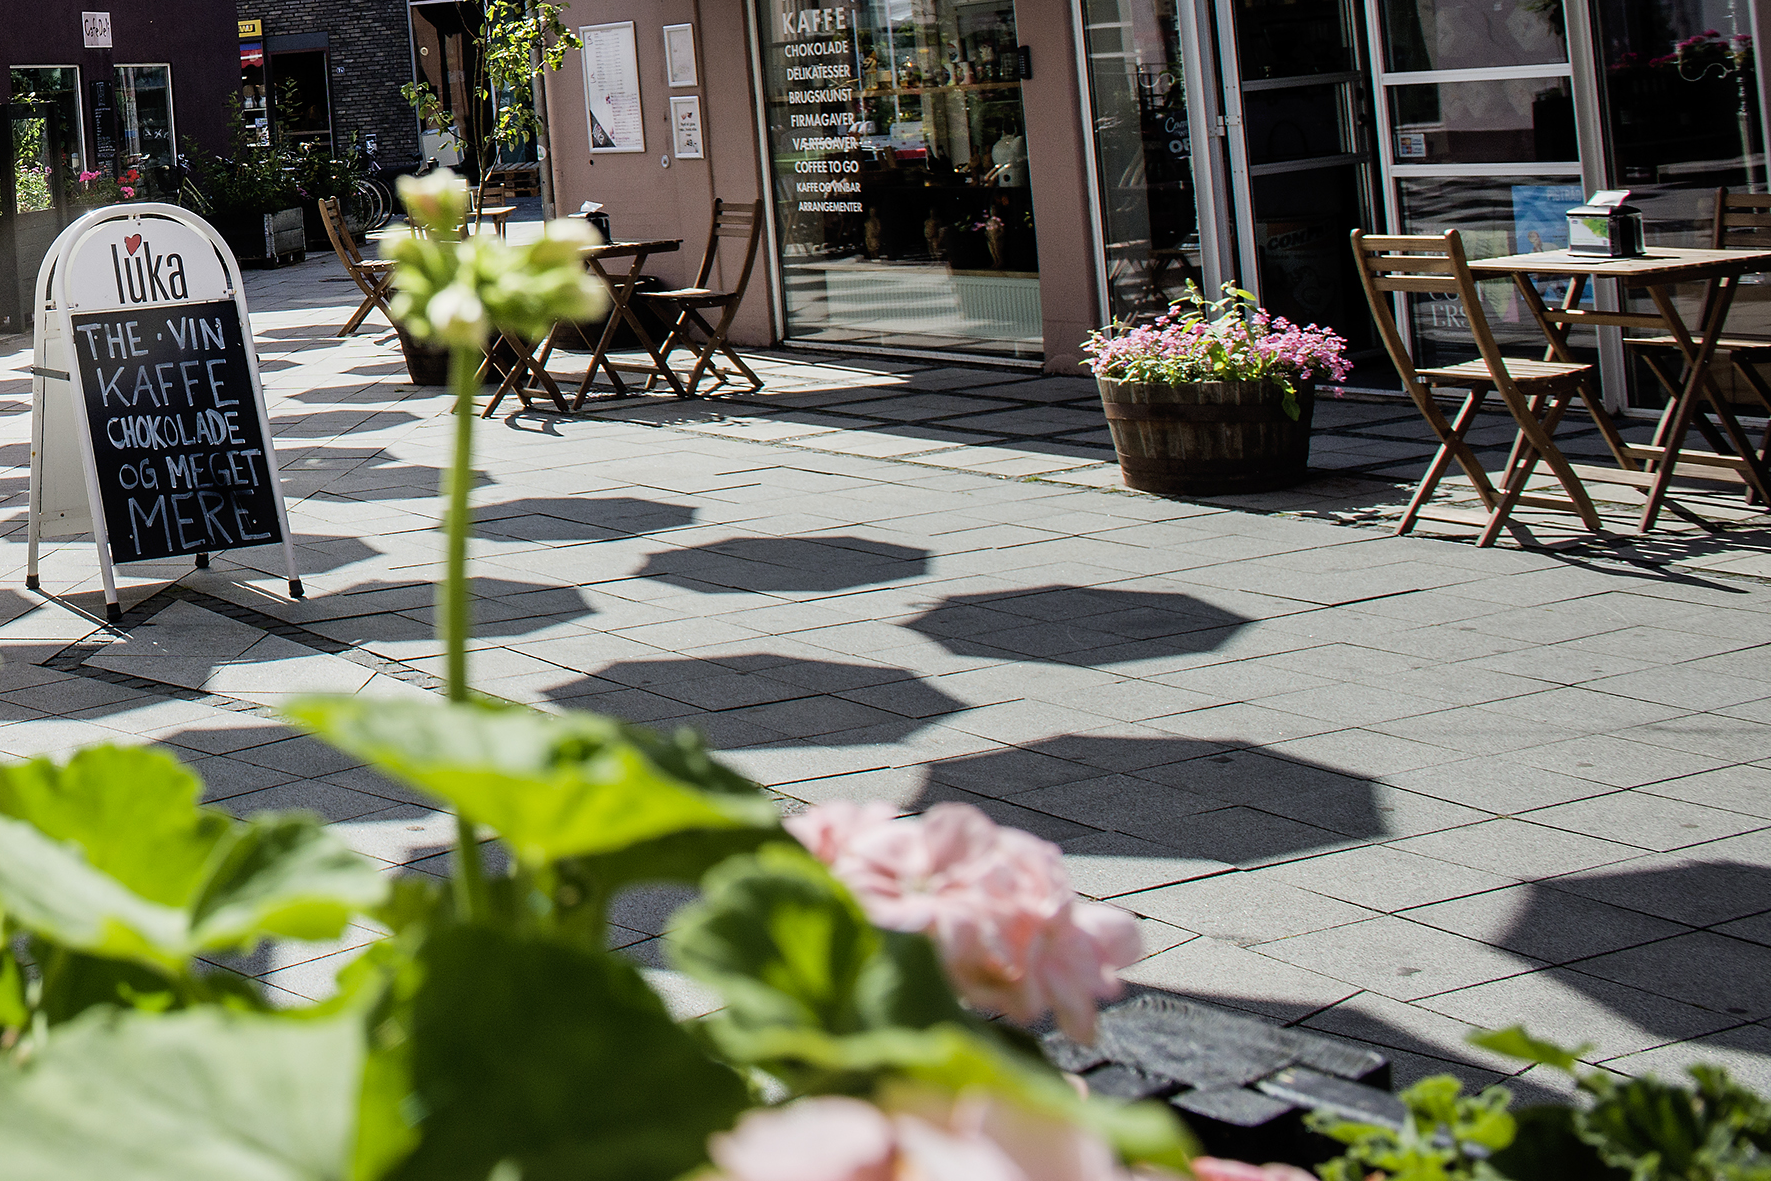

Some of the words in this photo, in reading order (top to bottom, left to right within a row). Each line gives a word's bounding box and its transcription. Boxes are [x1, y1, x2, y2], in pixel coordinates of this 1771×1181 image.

[782, 7, 846, 34] KAFFE
[785, 40, 849, 58] CHOKOLADE
[786, 64, 851, 81] DELIKATESSER
[788, 88, 852, 104] BRUGSKUNST
[790, 112, 855, 128] FIRMAGAVER
[792, 136, 857, 151] VÆRTSGAVER
[795, 161, 828, 173] COFFEE
[829, 161, 842, 173] TO
[843, 160, 859, 173] GO
[796, 182, 819, 193] KAFFE
[832, 182, 861, 193] VINBAR
[798, 201, 863, 212] ARRANGEMENTER
[110, 240, 189, 305] luka
[76, 320, 150, 360] THE
[165, 316, 226, 351] VIN
[96, 359, 240, 408] KAFFE
[106, 408, 246, 450] CHOKOLADE
[119, 458, 158, 490] OG
[166, 448, 262, 490] MEGET
[127, 489, 271, 555] MERE
